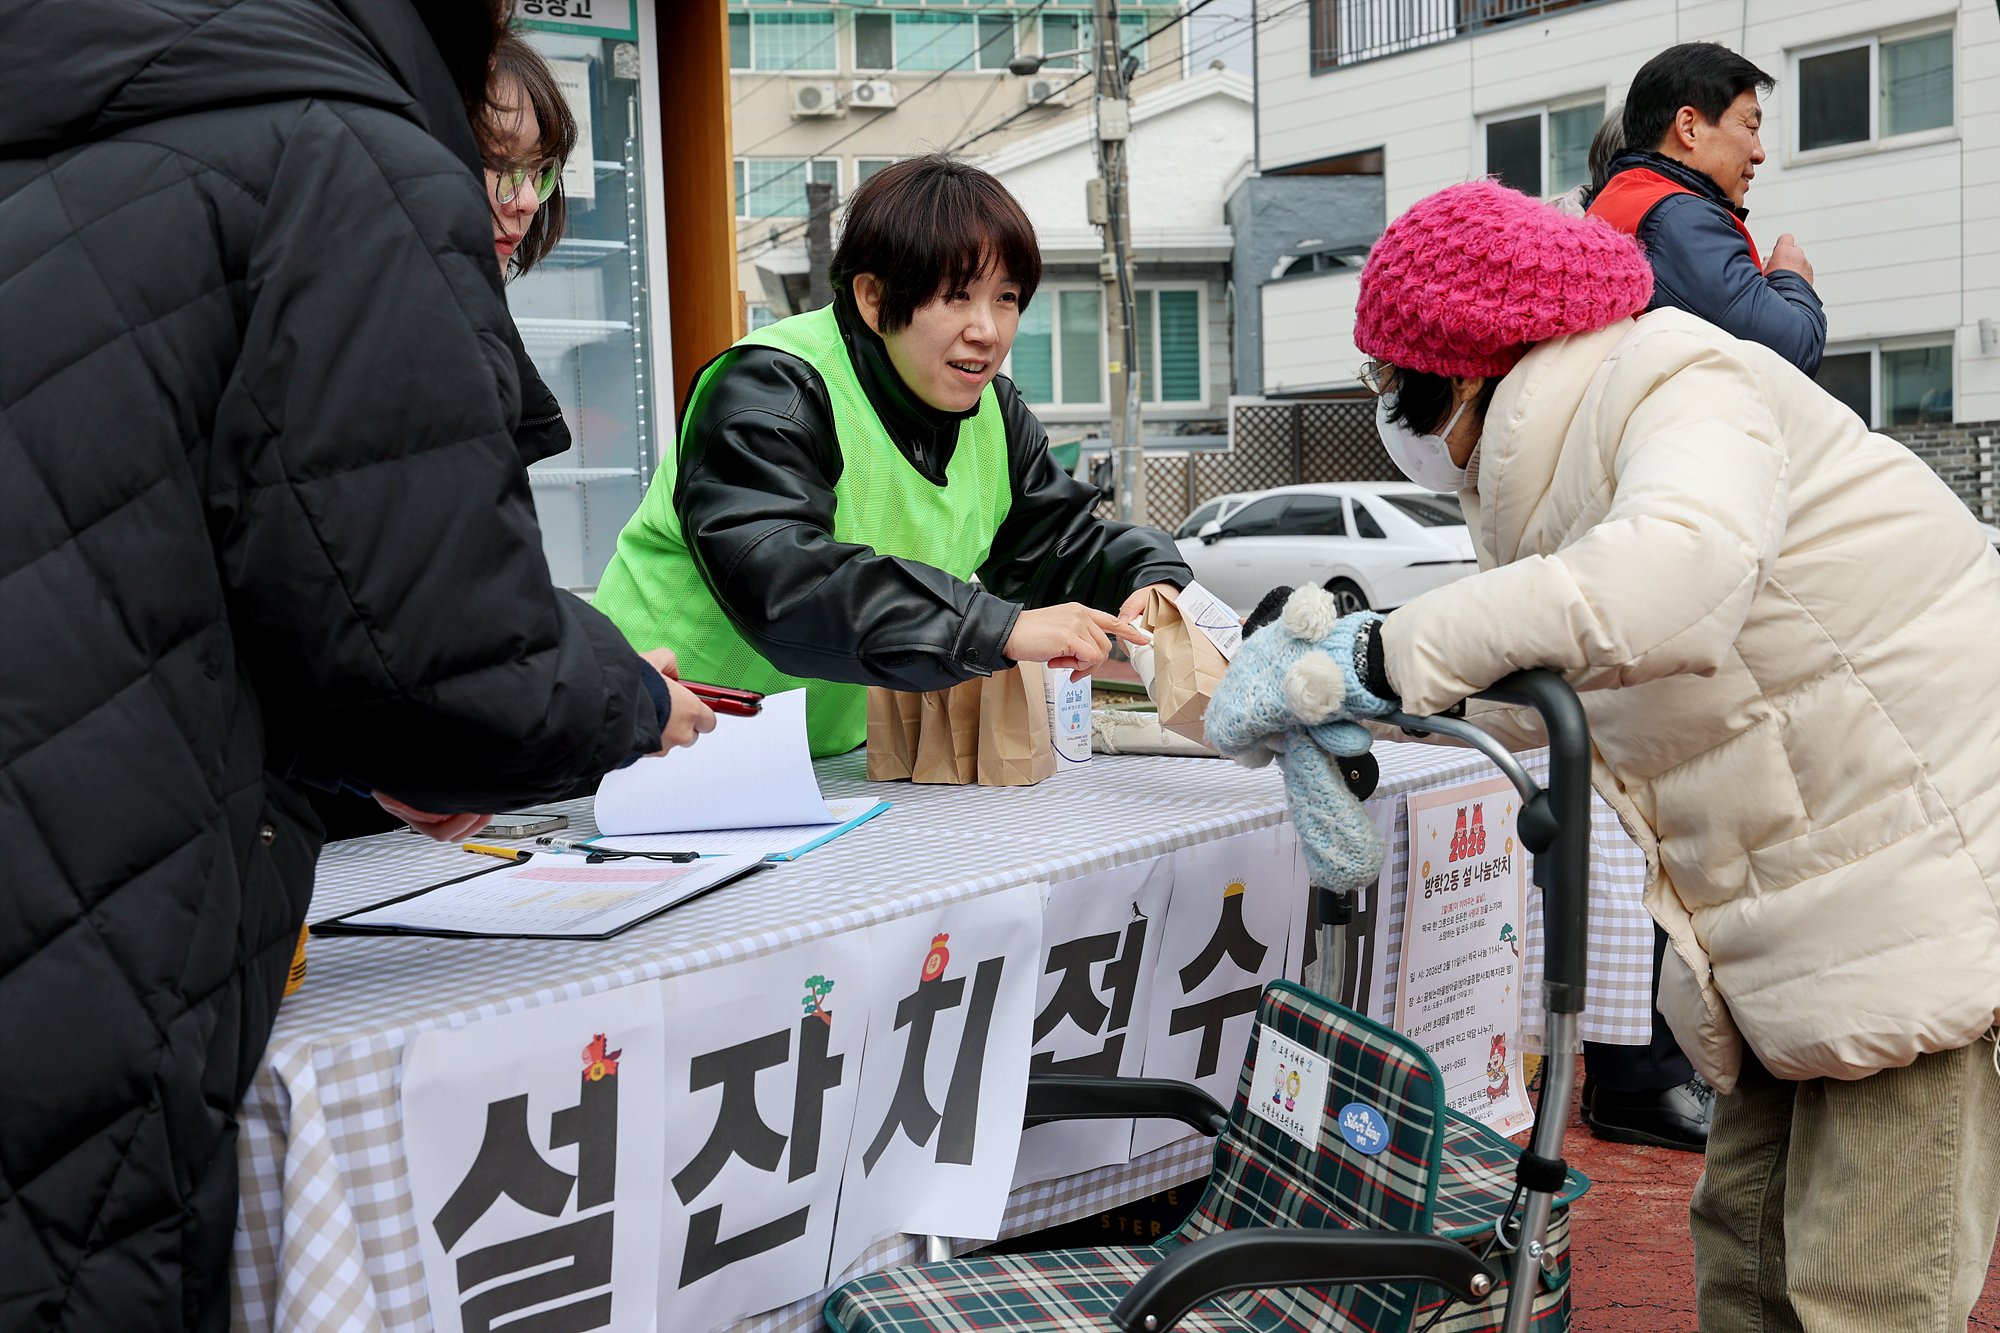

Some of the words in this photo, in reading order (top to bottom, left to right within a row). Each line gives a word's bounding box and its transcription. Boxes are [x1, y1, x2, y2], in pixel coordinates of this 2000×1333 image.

[1066, 689, 1083, 704] 설날
[1449, 830, 1486, 862] 2026
[1424, 869, 1459, 899] 방학2동
[1462, 866, 1472, 888] 설
[1474, 854, 1510, 882] 나눔잔치
[1432, 920, 1437, 931] 한
[1438, 916, 1454, 929] 그릇으로
[1455, 912, 1467, 924] 든든한
[1409, 971, 1416, 983] 일
[1426, 963, 1442, 977] 2026년
[1443, 960, 1450, 972] 2월
[1468, 951, 1477, 962] 떡국
[1408, 997, 1414, 1008] 장
[1407, 1028, 1412, 1038] 대
[1422, 1021, 1432, 1033] 사전
[1466, 1005, 1476, 1017] 주민
[1436, 1040, 1444, 1053] 함께
[1445, 1037, 1455, 1048] 떡국
[1477, 1023, 1494, 1037] 나누기
[1344, 1111, 1365, 1134] Silver
[1364, 1121, 1381, 1146] king
